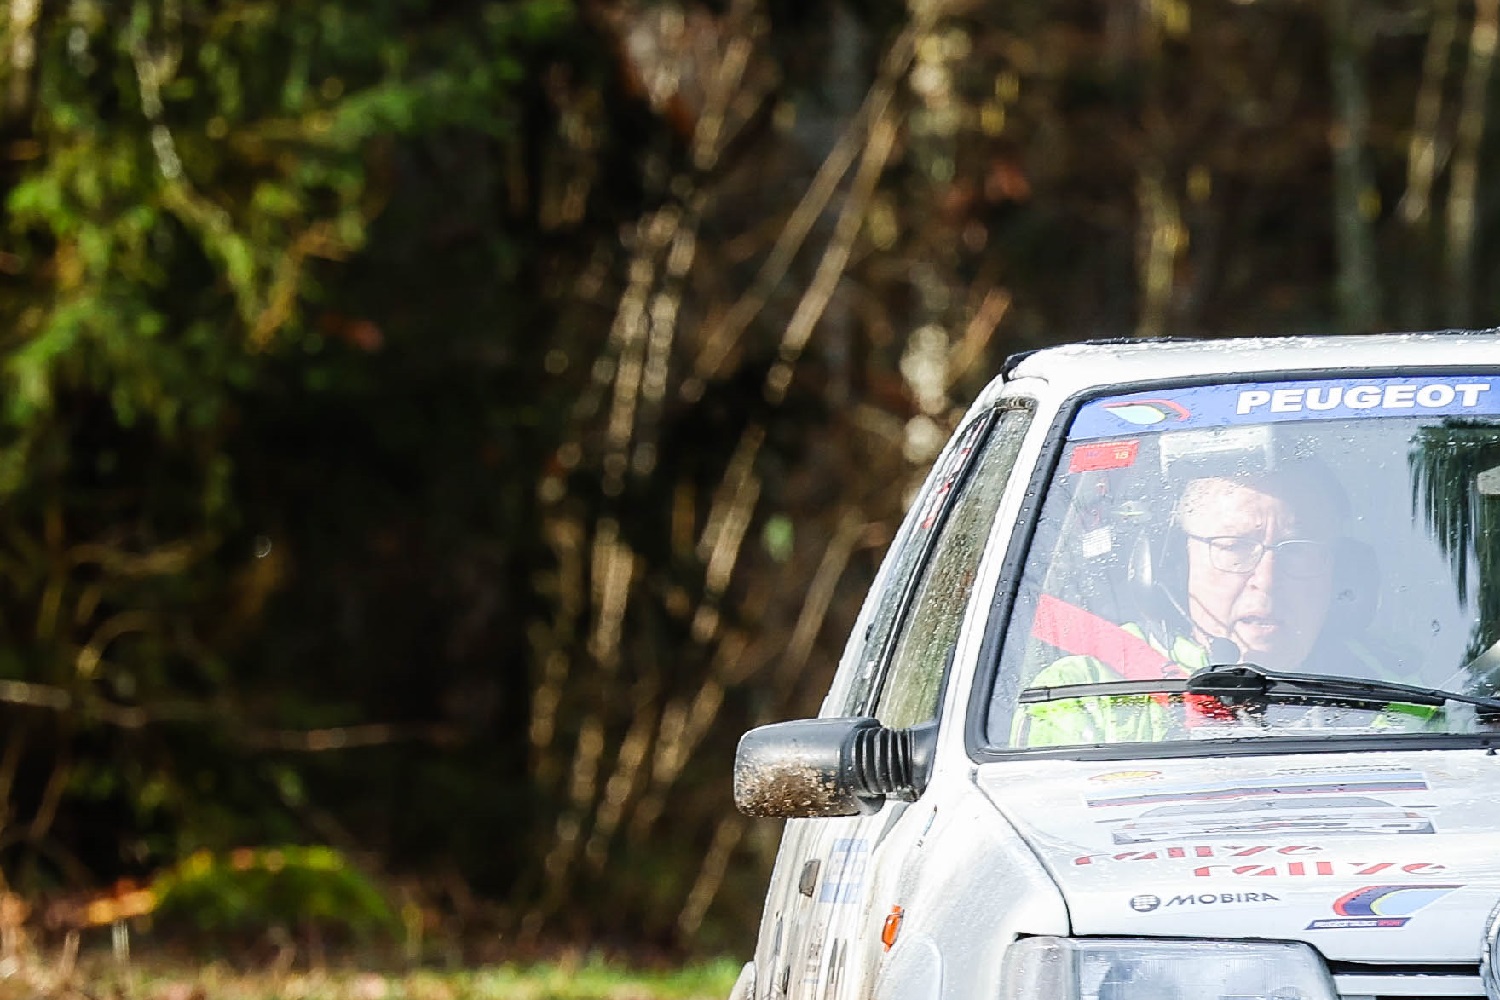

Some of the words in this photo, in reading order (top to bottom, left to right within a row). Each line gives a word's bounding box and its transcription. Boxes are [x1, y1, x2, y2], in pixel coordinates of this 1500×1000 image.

[1237, 382, 1491, 415] PEUGEOT
[1074, 845, 1324, 866] rallye
[1194, 861, 1446, 877] rallye
[1166, 892, 1281, 907] MOBIRA
